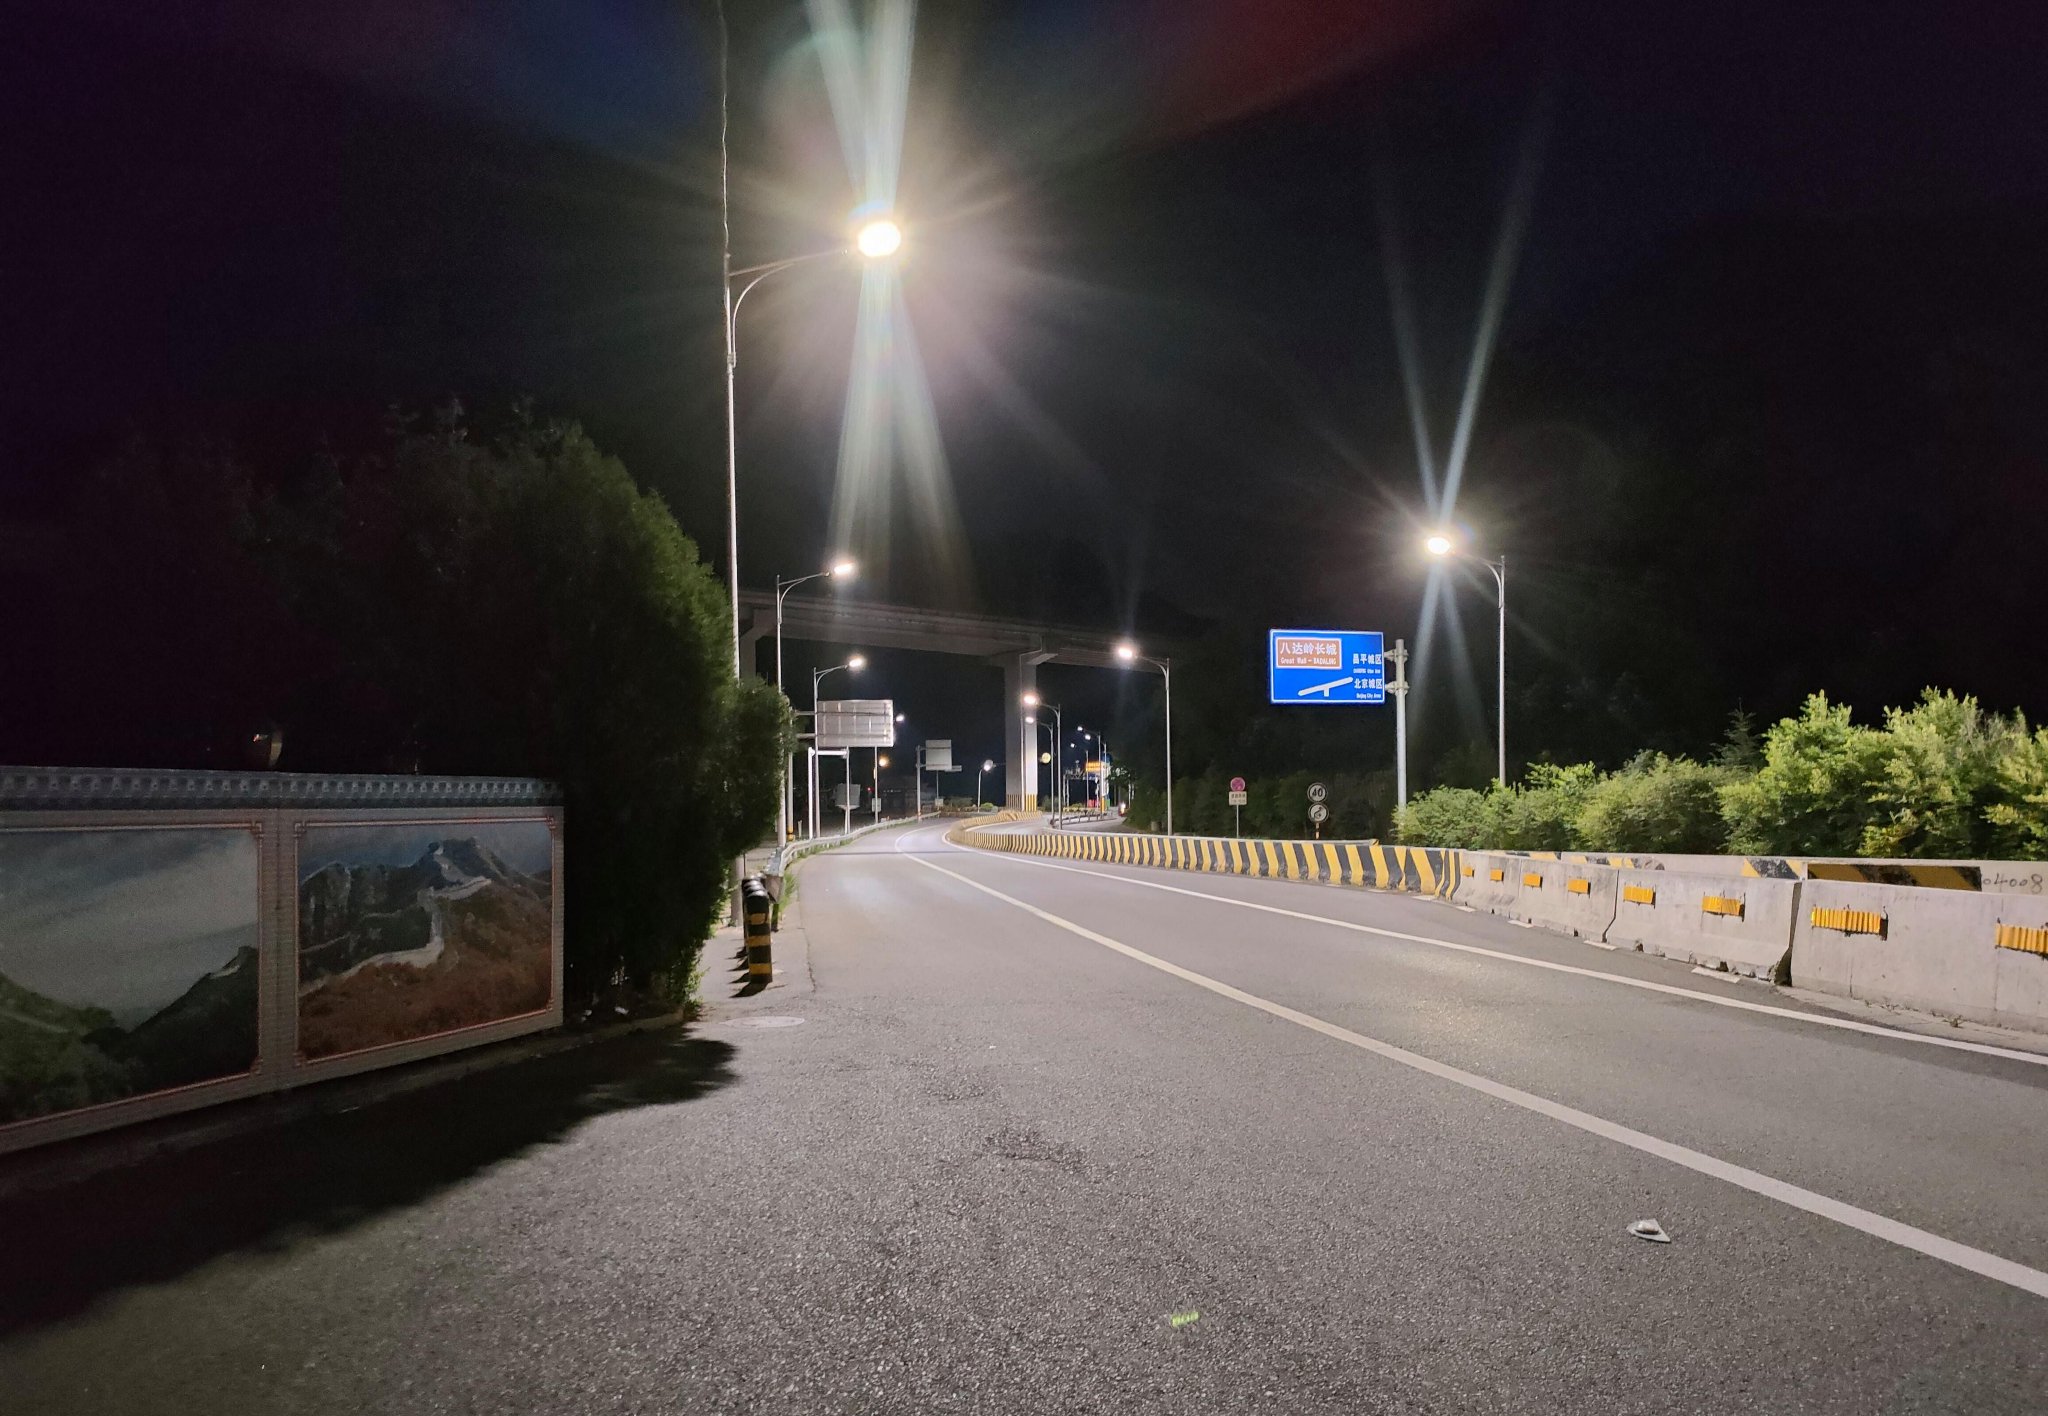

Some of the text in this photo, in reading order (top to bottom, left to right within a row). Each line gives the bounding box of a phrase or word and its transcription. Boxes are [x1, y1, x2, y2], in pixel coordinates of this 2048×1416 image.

[1280, 642, 1337, 655] 八达岭长城
[1353, 653, 1382, 665] 昌平城区
[1354, 678, 1382, 689] 北京城区
[1312, 788, 1323, 797] 40
